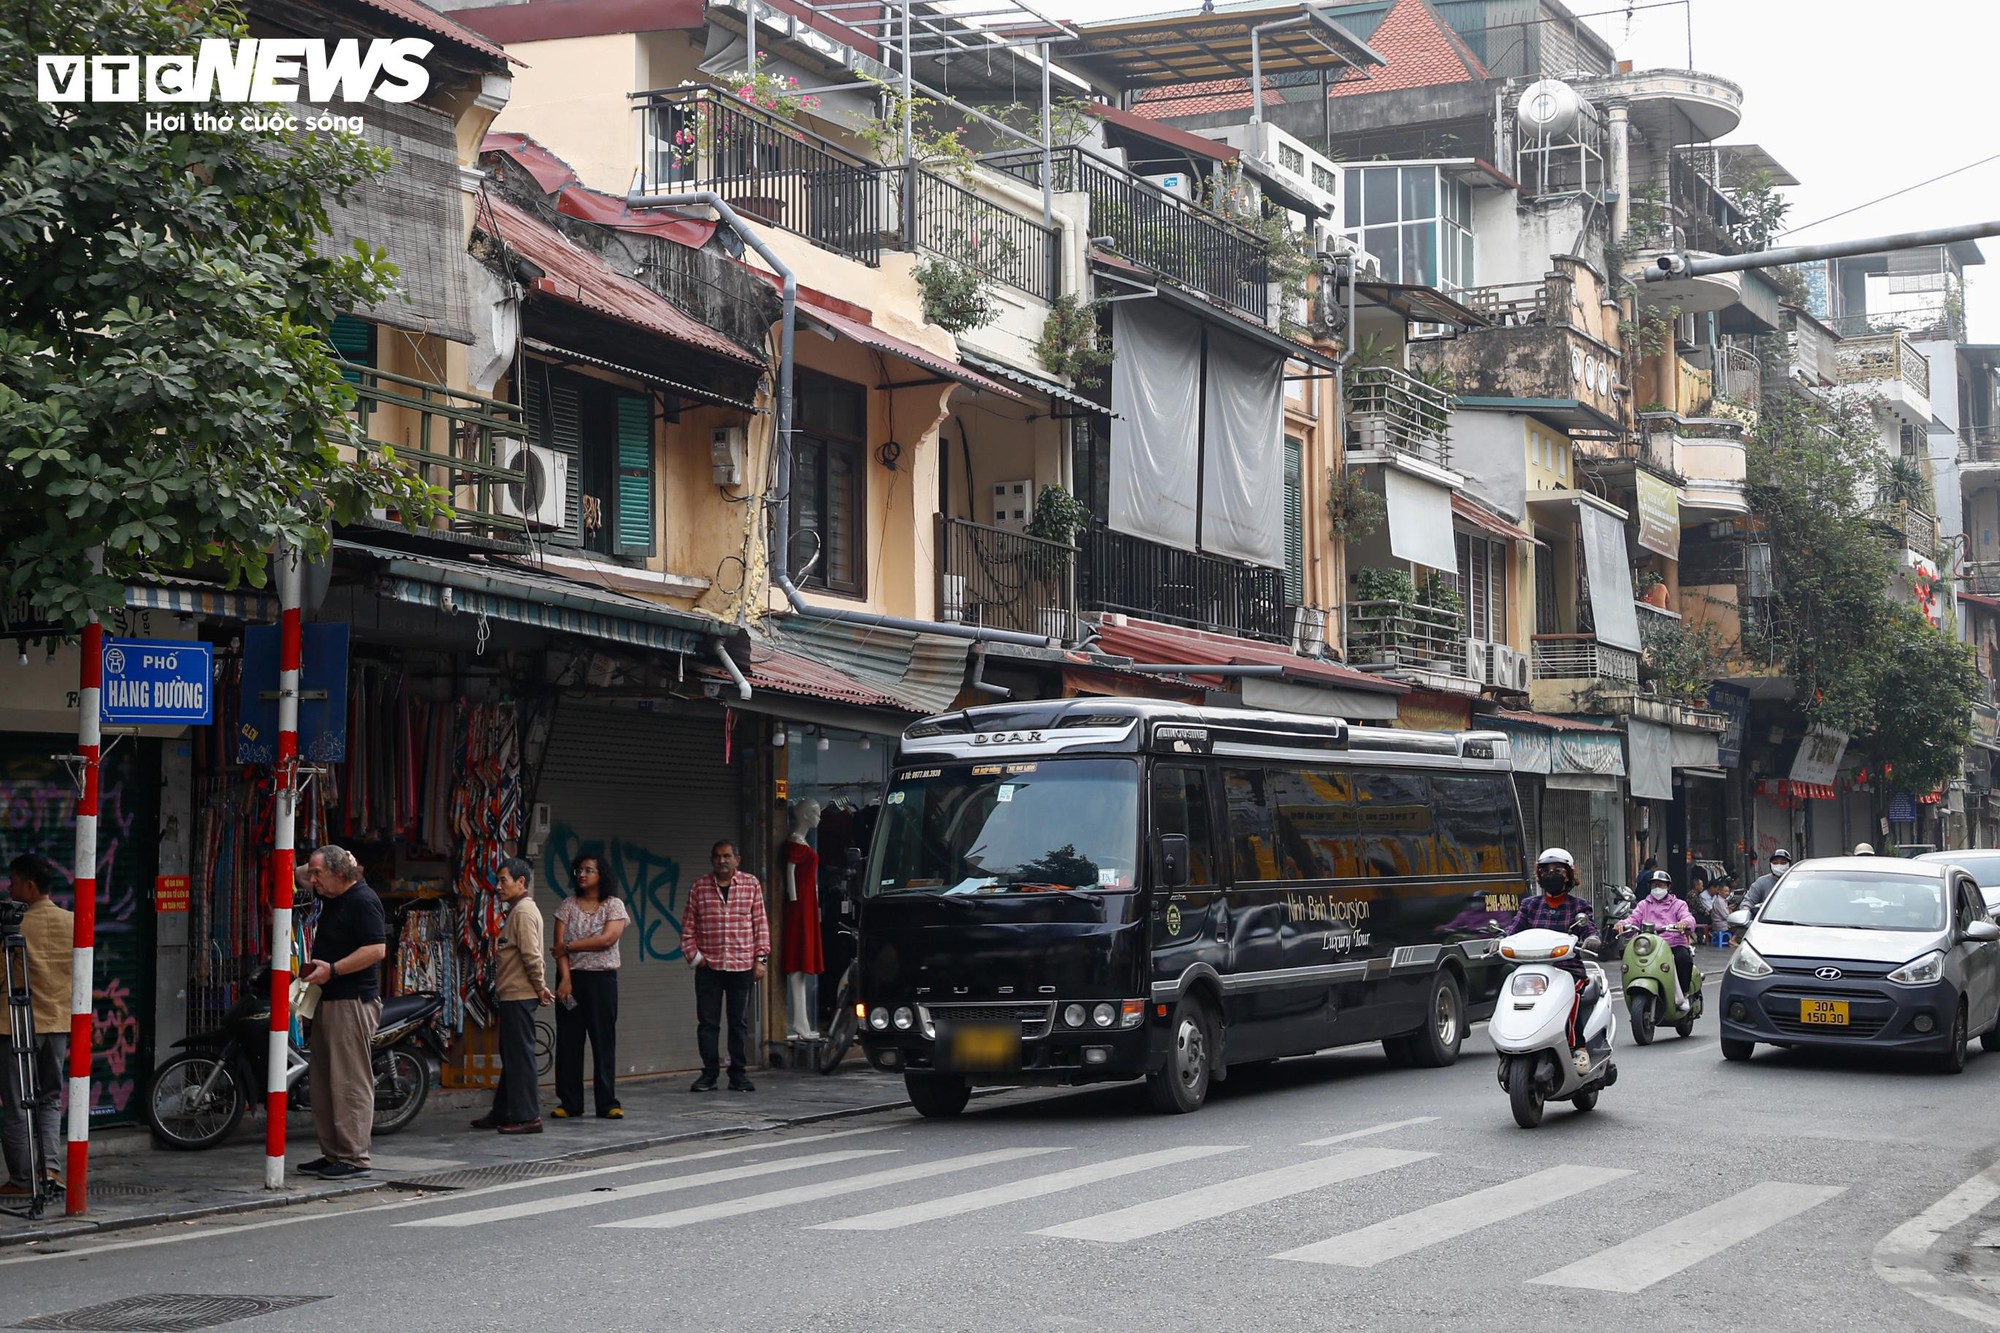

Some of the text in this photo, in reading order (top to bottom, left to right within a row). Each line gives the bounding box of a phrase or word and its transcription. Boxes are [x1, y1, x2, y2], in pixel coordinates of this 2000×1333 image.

[143, 651, 179, 670] PHỐ
[108, 673, 149, 708] HÀNG
[154, 675, 203, 709] ĐƯỜNG
[974, 731, 1042, 744] DCAR
[1471, 748, 1494, 758] DCAR
[1287, 892, 1306, 923] Ninh
[1329, 894, 1370, 929] Excursion
[1322, 928, 1371, 954] Luxury Tour
[916, 985, 1057, 995] FUSO
[1814, 1001, 1835, 1012] 30A
[1807, 1012, 1844, 1024] 150.30
